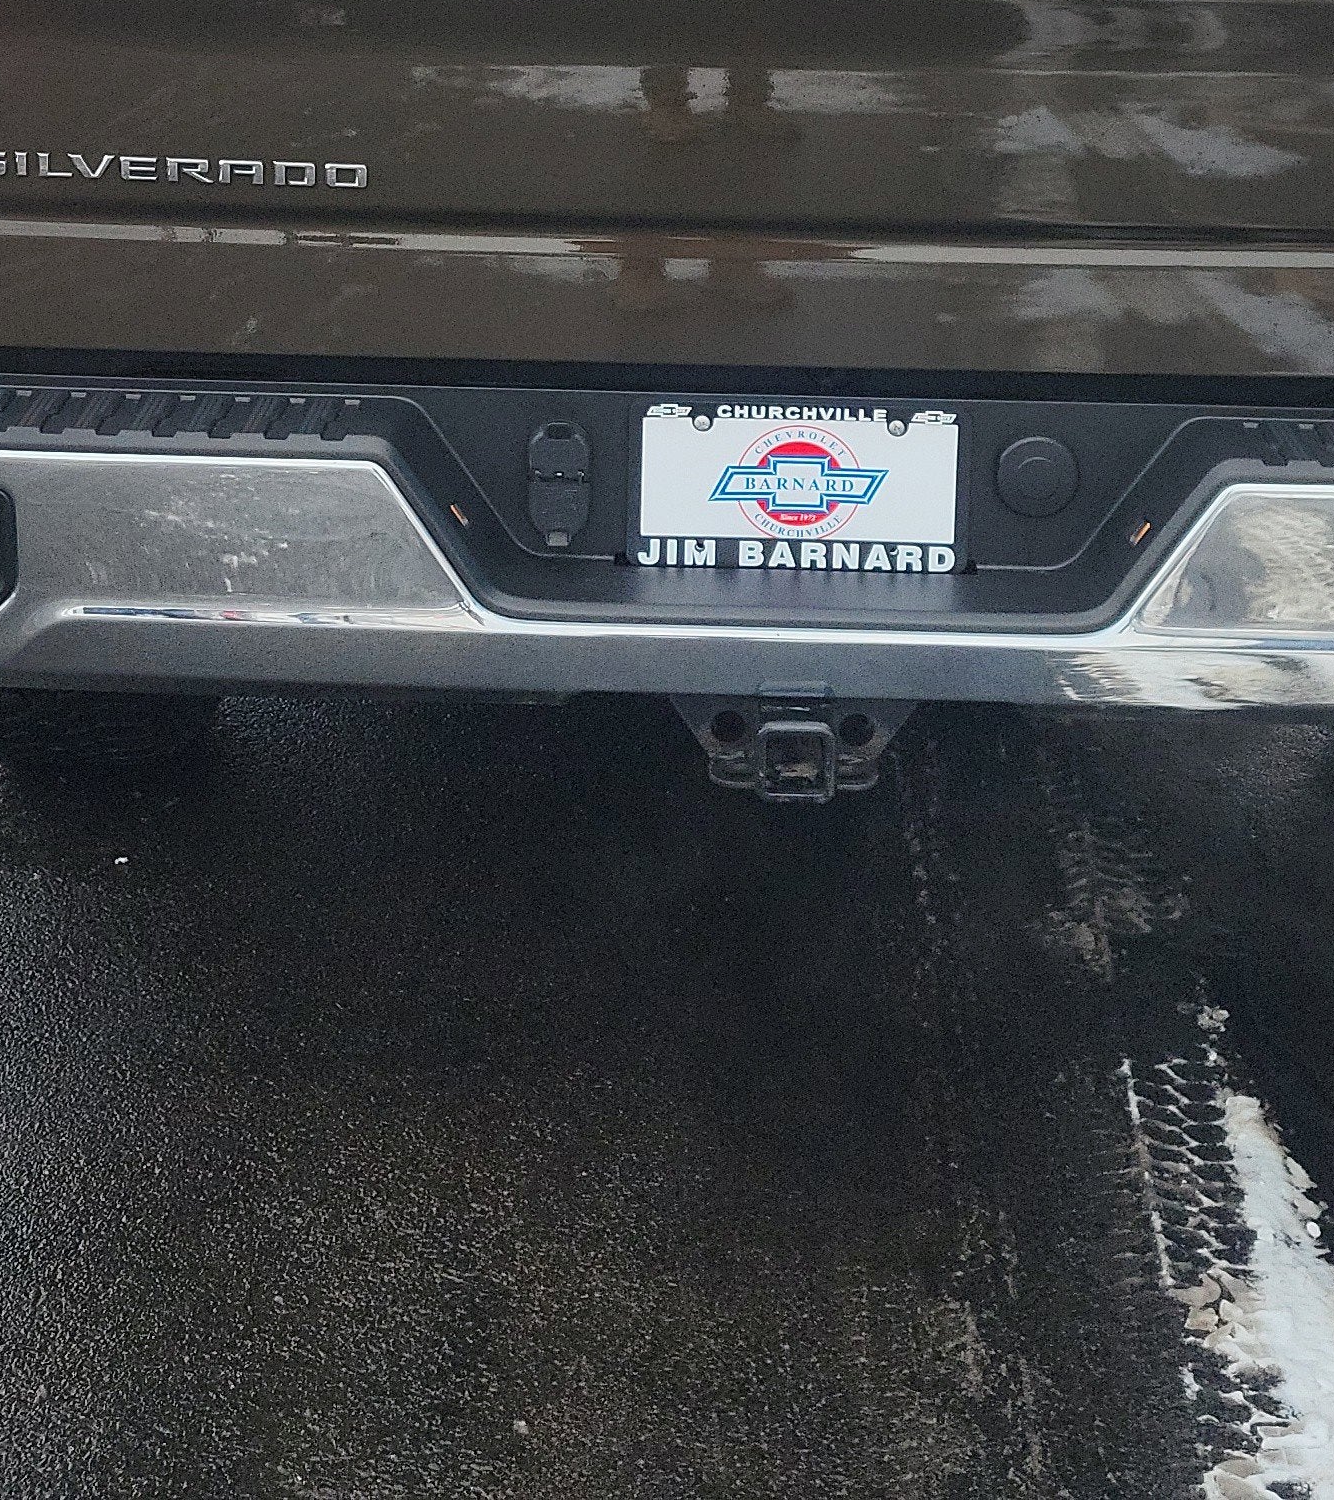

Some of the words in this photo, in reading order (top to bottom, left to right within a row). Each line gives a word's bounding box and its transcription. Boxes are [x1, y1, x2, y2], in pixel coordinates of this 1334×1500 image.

[717, 404, 887, 422] CHURCHVILLE
[754, 430, 846, 457] CHEVROLET
[745, 477, 854, 492] BARNARD
[754, 513, 842, 538] CHURCHVILLE
[638, 538, 716, 567] JIM
[739, 540, 956, 573] BARNARD
